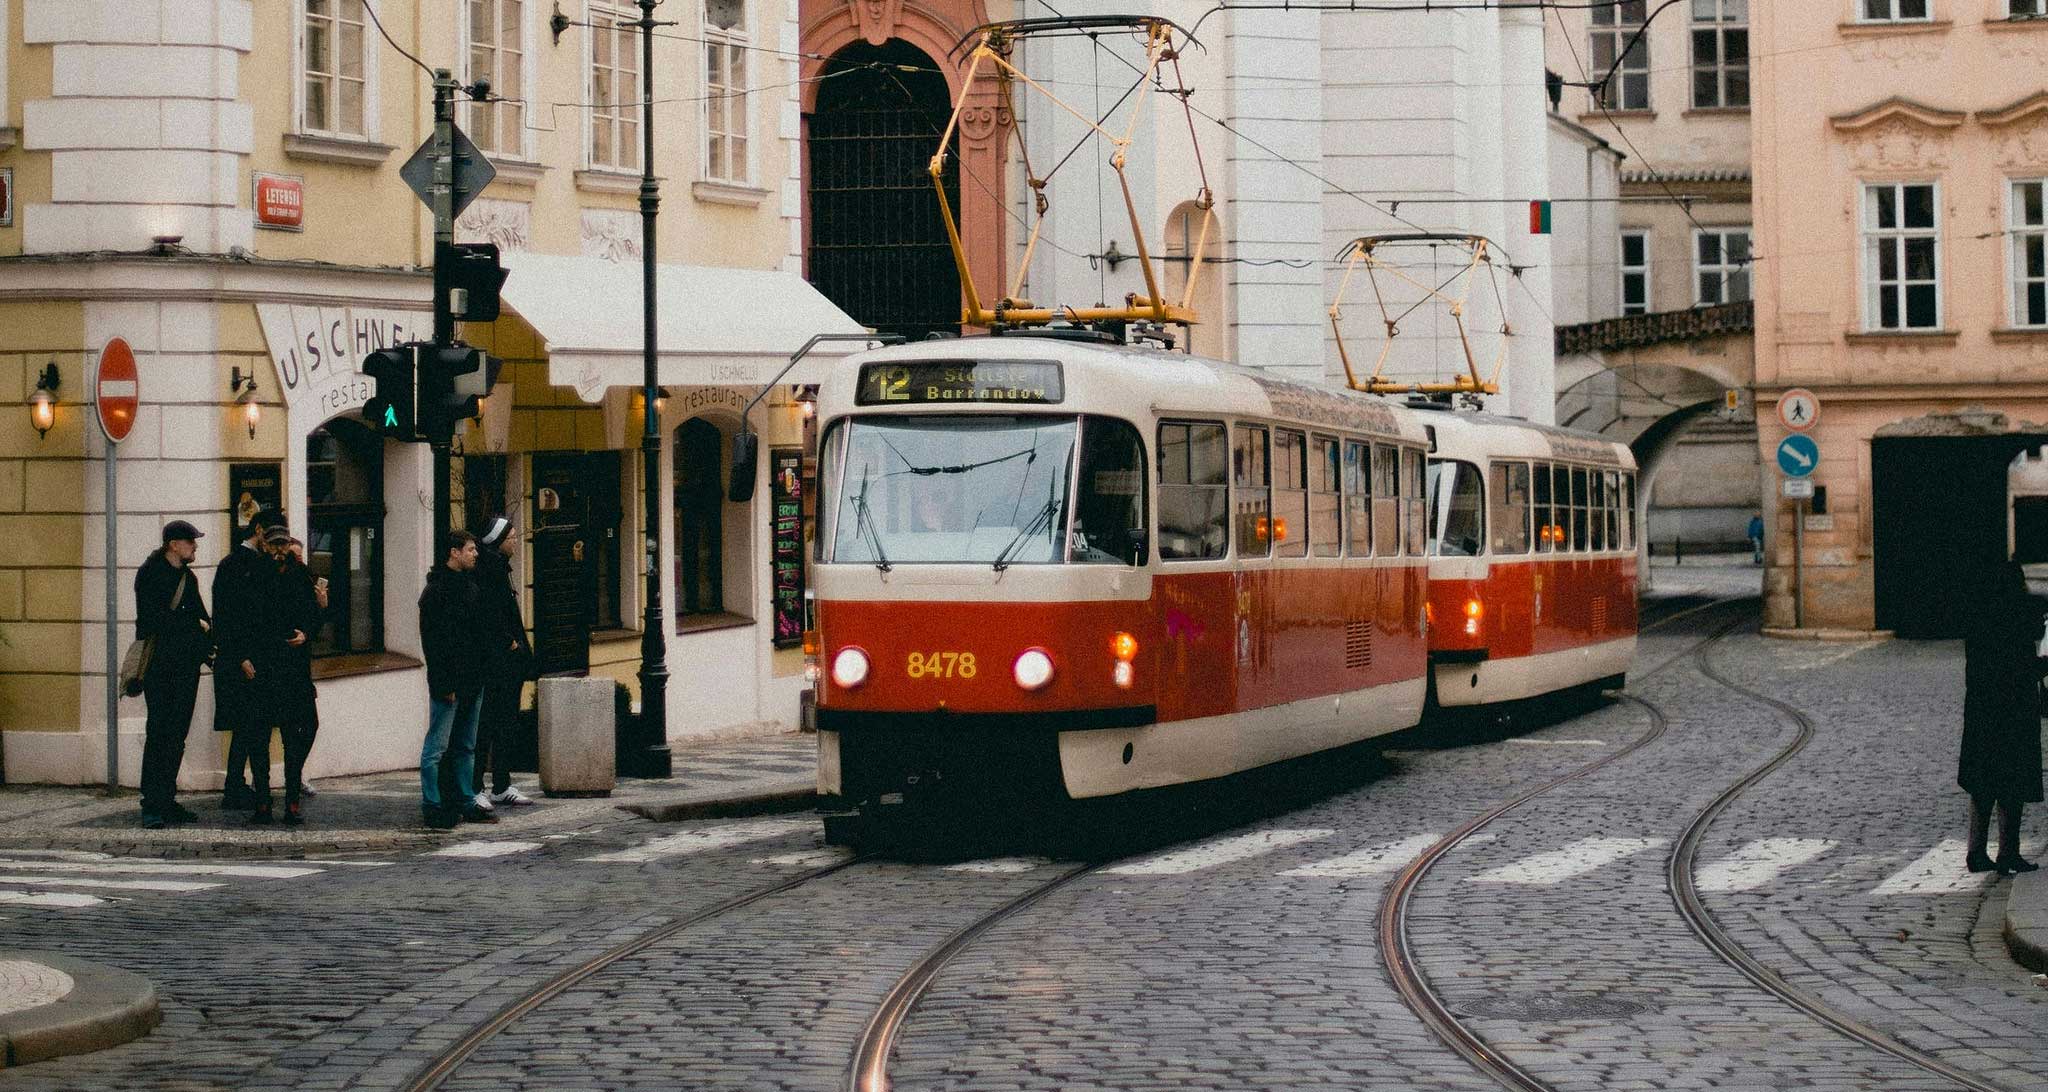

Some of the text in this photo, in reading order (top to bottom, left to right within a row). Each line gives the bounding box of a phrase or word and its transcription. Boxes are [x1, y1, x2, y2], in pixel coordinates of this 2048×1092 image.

[280, 318, 423, 390] U SCHNE
[710, 364, 717, 380] U
[870, 367, 912, 400] 12
[321, 378, 375, 415] resta
[927, 385, 1046, 400] Barrandov
[907, 651, 977, 679] 8478
